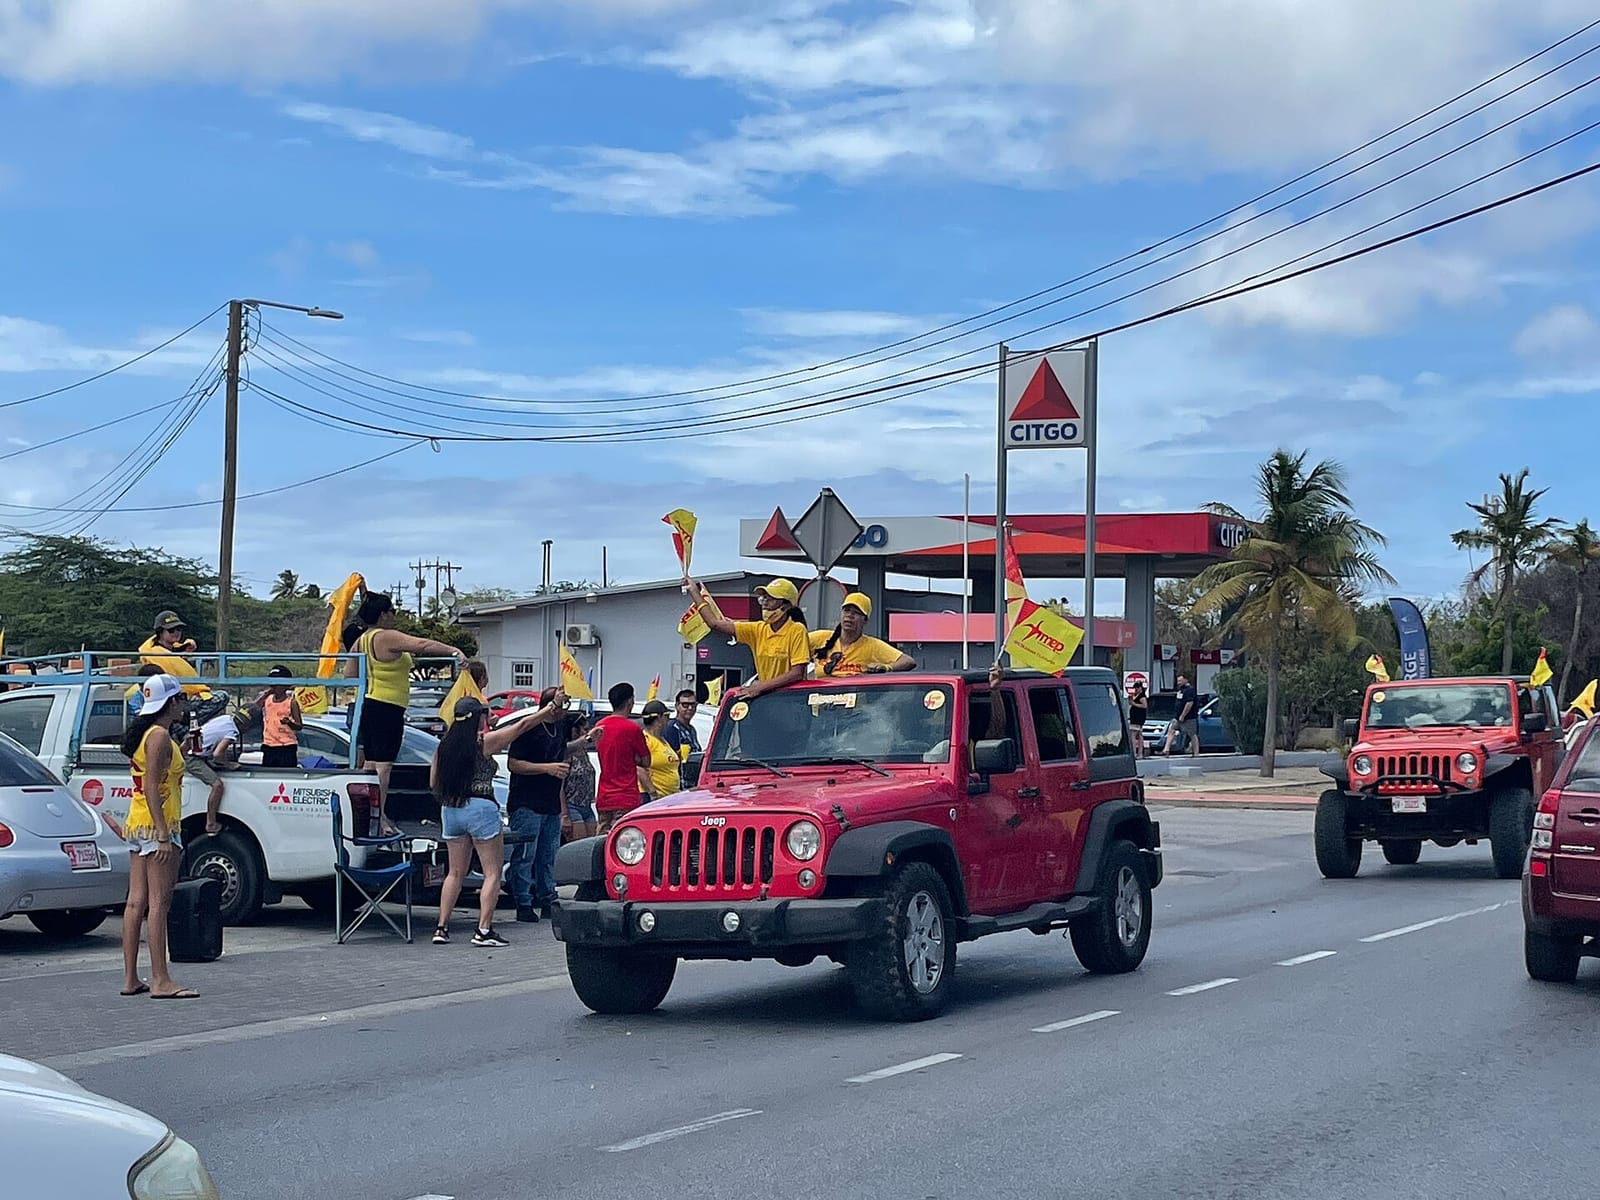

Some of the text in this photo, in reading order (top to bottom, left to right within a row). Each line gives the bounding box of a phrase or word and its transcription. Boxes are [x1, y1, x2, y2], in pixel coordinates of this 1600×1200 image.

[1010, 423, 1078, 442] CITGO
[1220, 522, 1250, 548] CITG
[293, 788, 333, 798] MITSUBISH
[293, 796, 329, 805] ELECTRIC
[700, 815, 726, 827] Jeep
